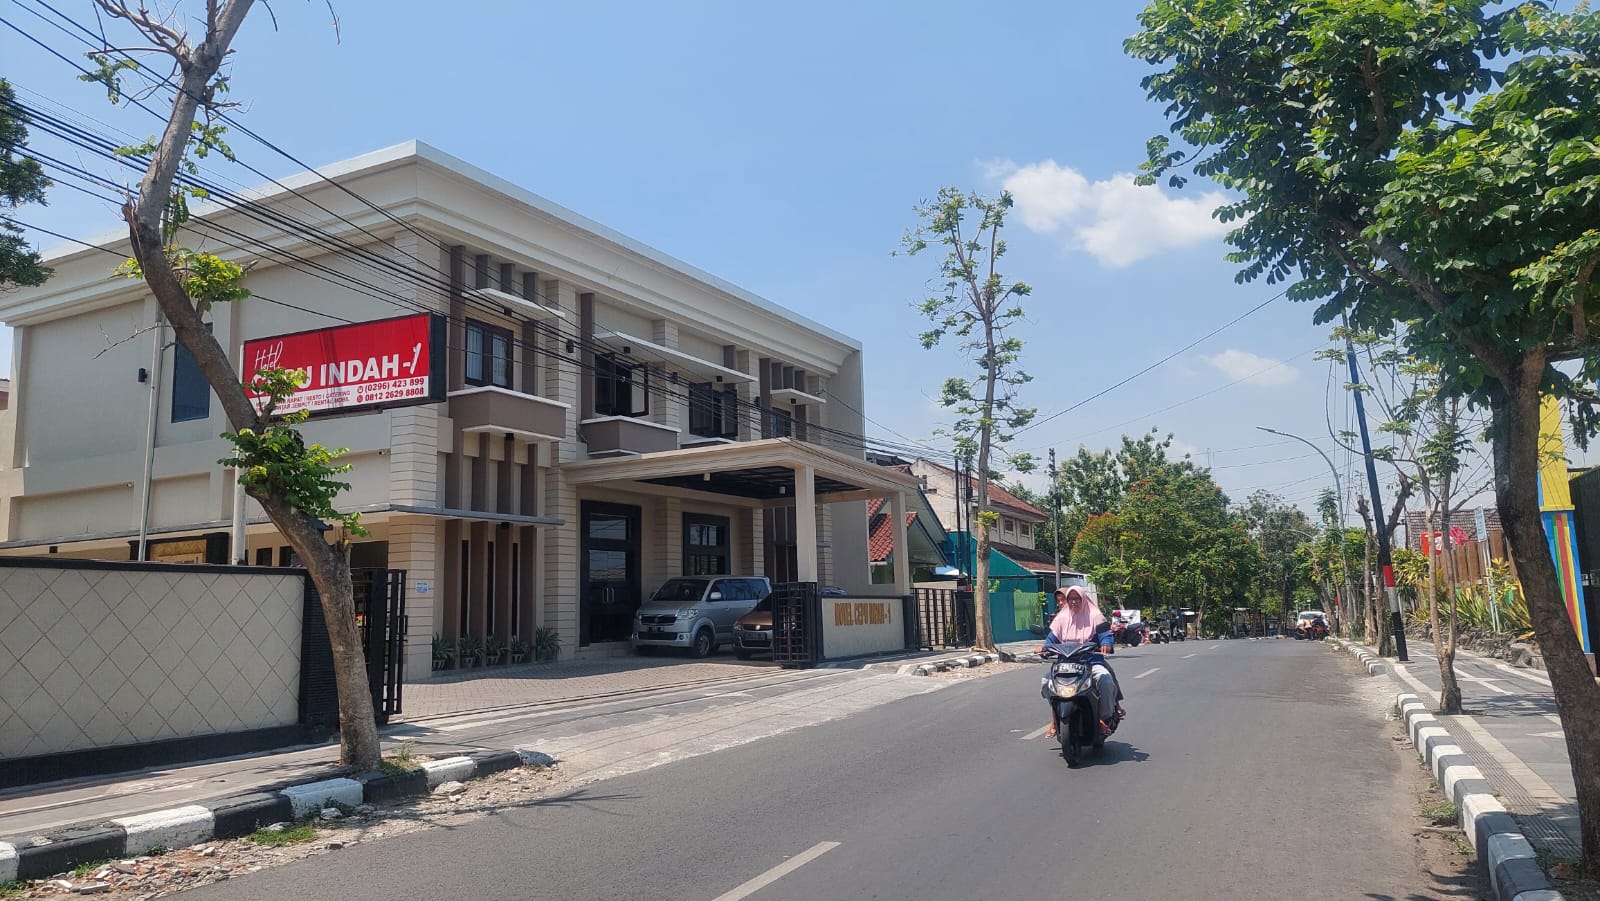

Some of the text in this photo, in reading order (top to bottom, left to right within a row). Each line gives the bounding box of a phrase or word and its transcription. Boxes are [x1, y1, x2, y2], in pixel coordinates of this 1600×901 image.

[254, 340, 283, 370] Hotel
[365, 377, 425, 394] (0296) 423 899
[305, 394, 322, 402] RESTO
[365, 387, 425, 402] 0812 2629 8808
[834, 602, 854, 626] HOTEL
[854, 602, 869, 625] CEPU
